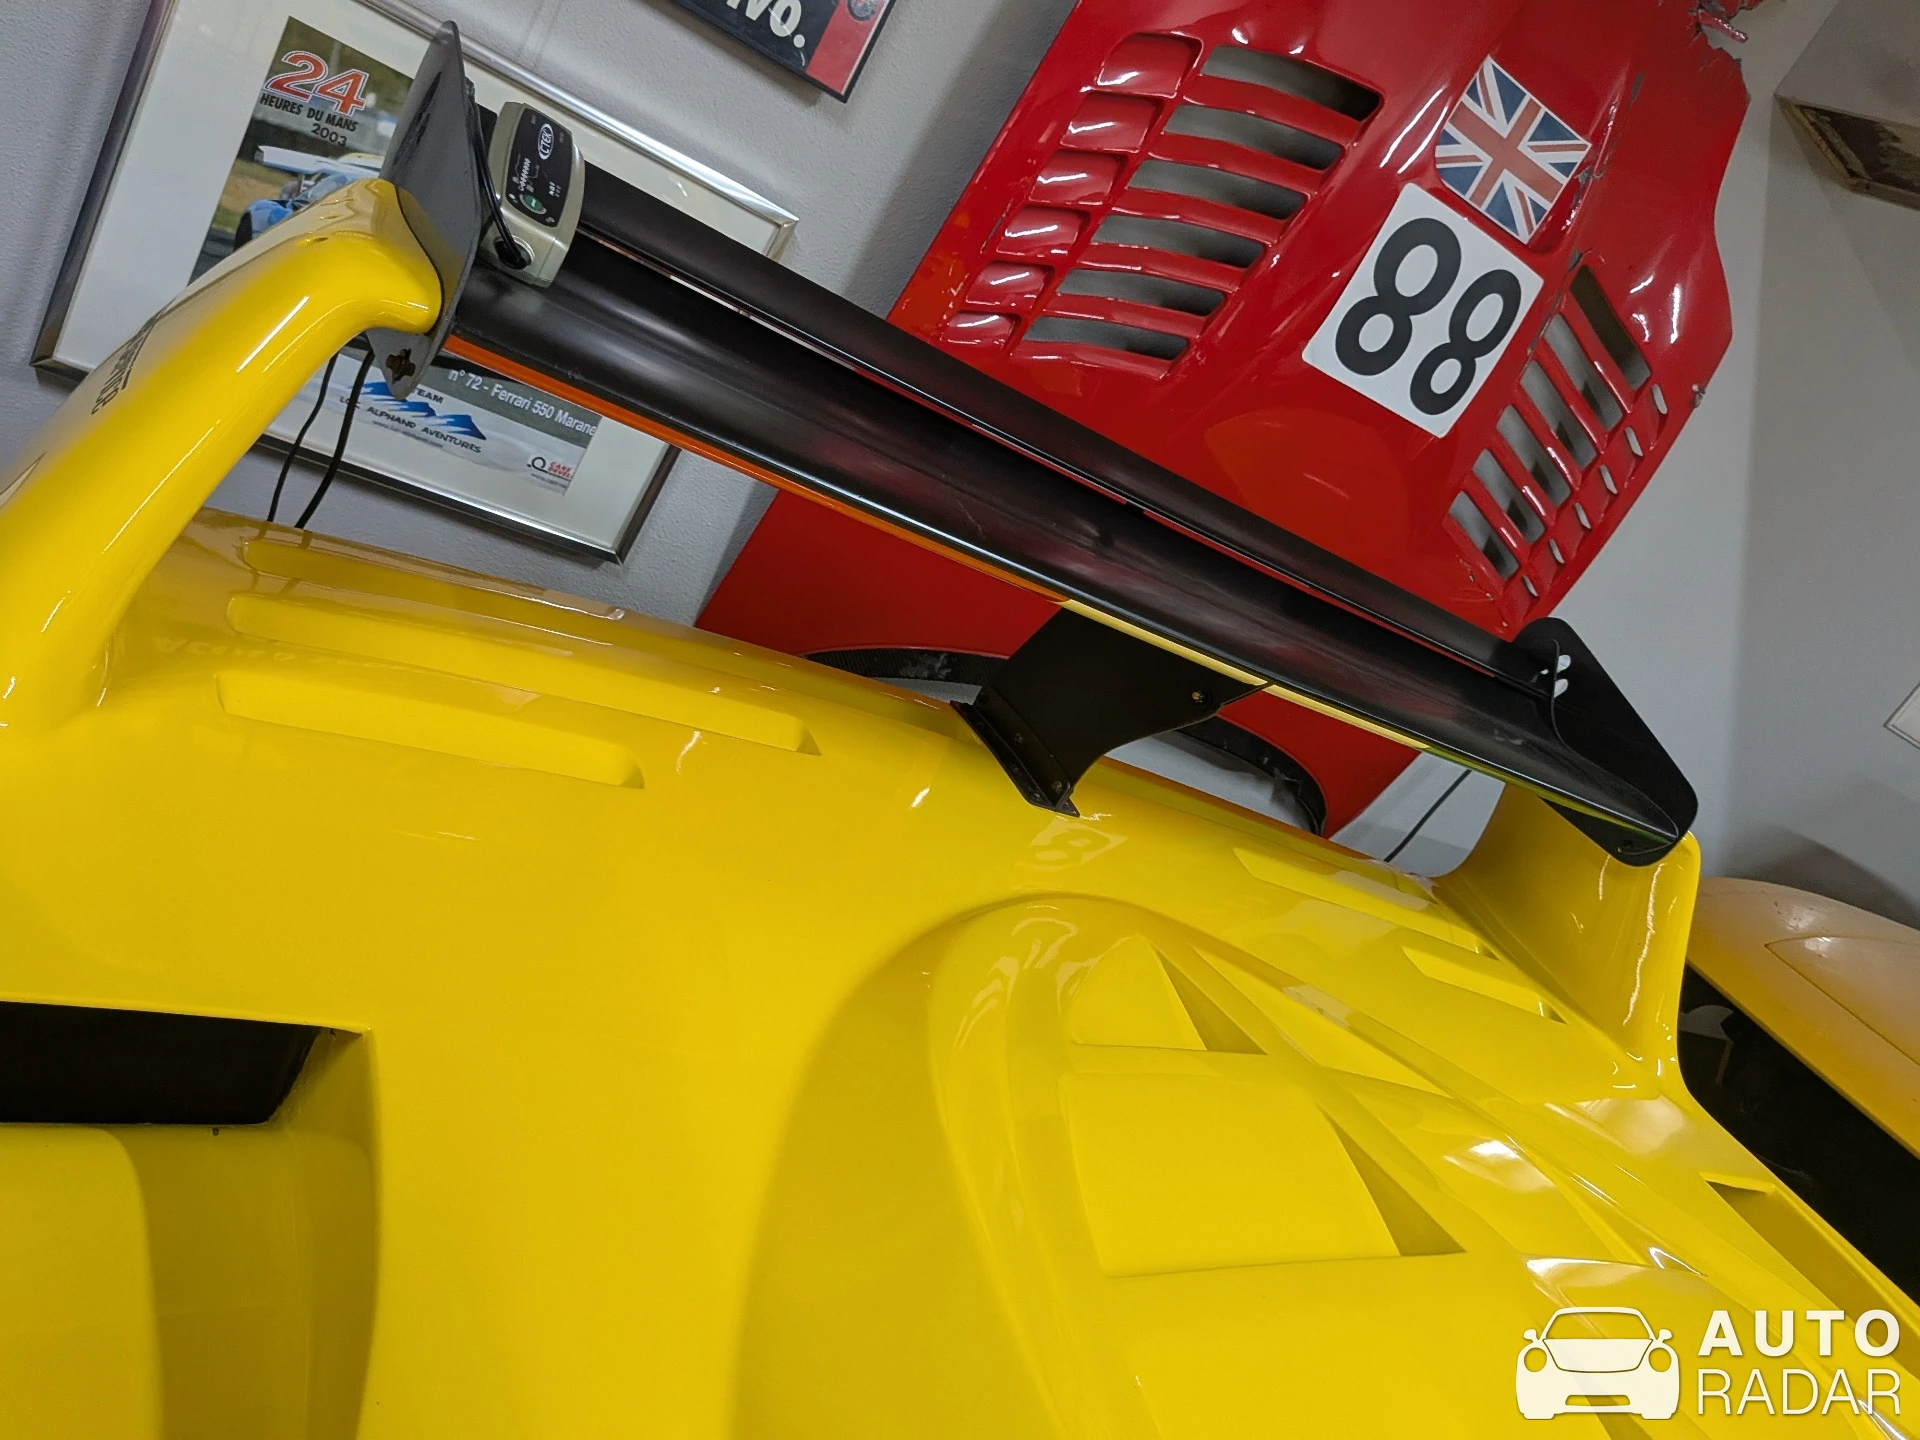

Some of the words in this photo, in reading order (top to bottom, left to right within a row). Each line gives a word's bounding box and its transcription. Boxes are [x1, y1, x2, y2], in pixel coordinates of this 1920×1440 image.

[263, 50, 369, 117] 24
[260, 94, 304, 115] HEURES
[306, 107, 324, 122] DU
[325, 113, 359, 132] MANS
[311, 122, 348, 147] 2003
[539, 127, 553, 154] CTEK
[1335, 217, 1522, 416] 88
[465, 374, 482, 391] 72
[490, 383, 532, 410] Ferrari
[532, 400, 555, 419] 550
[554, 409, 597, 436] Marane
[367, 406, 417, 429] ALPHAND
[421, 427, 482, 453] AVENTURES
